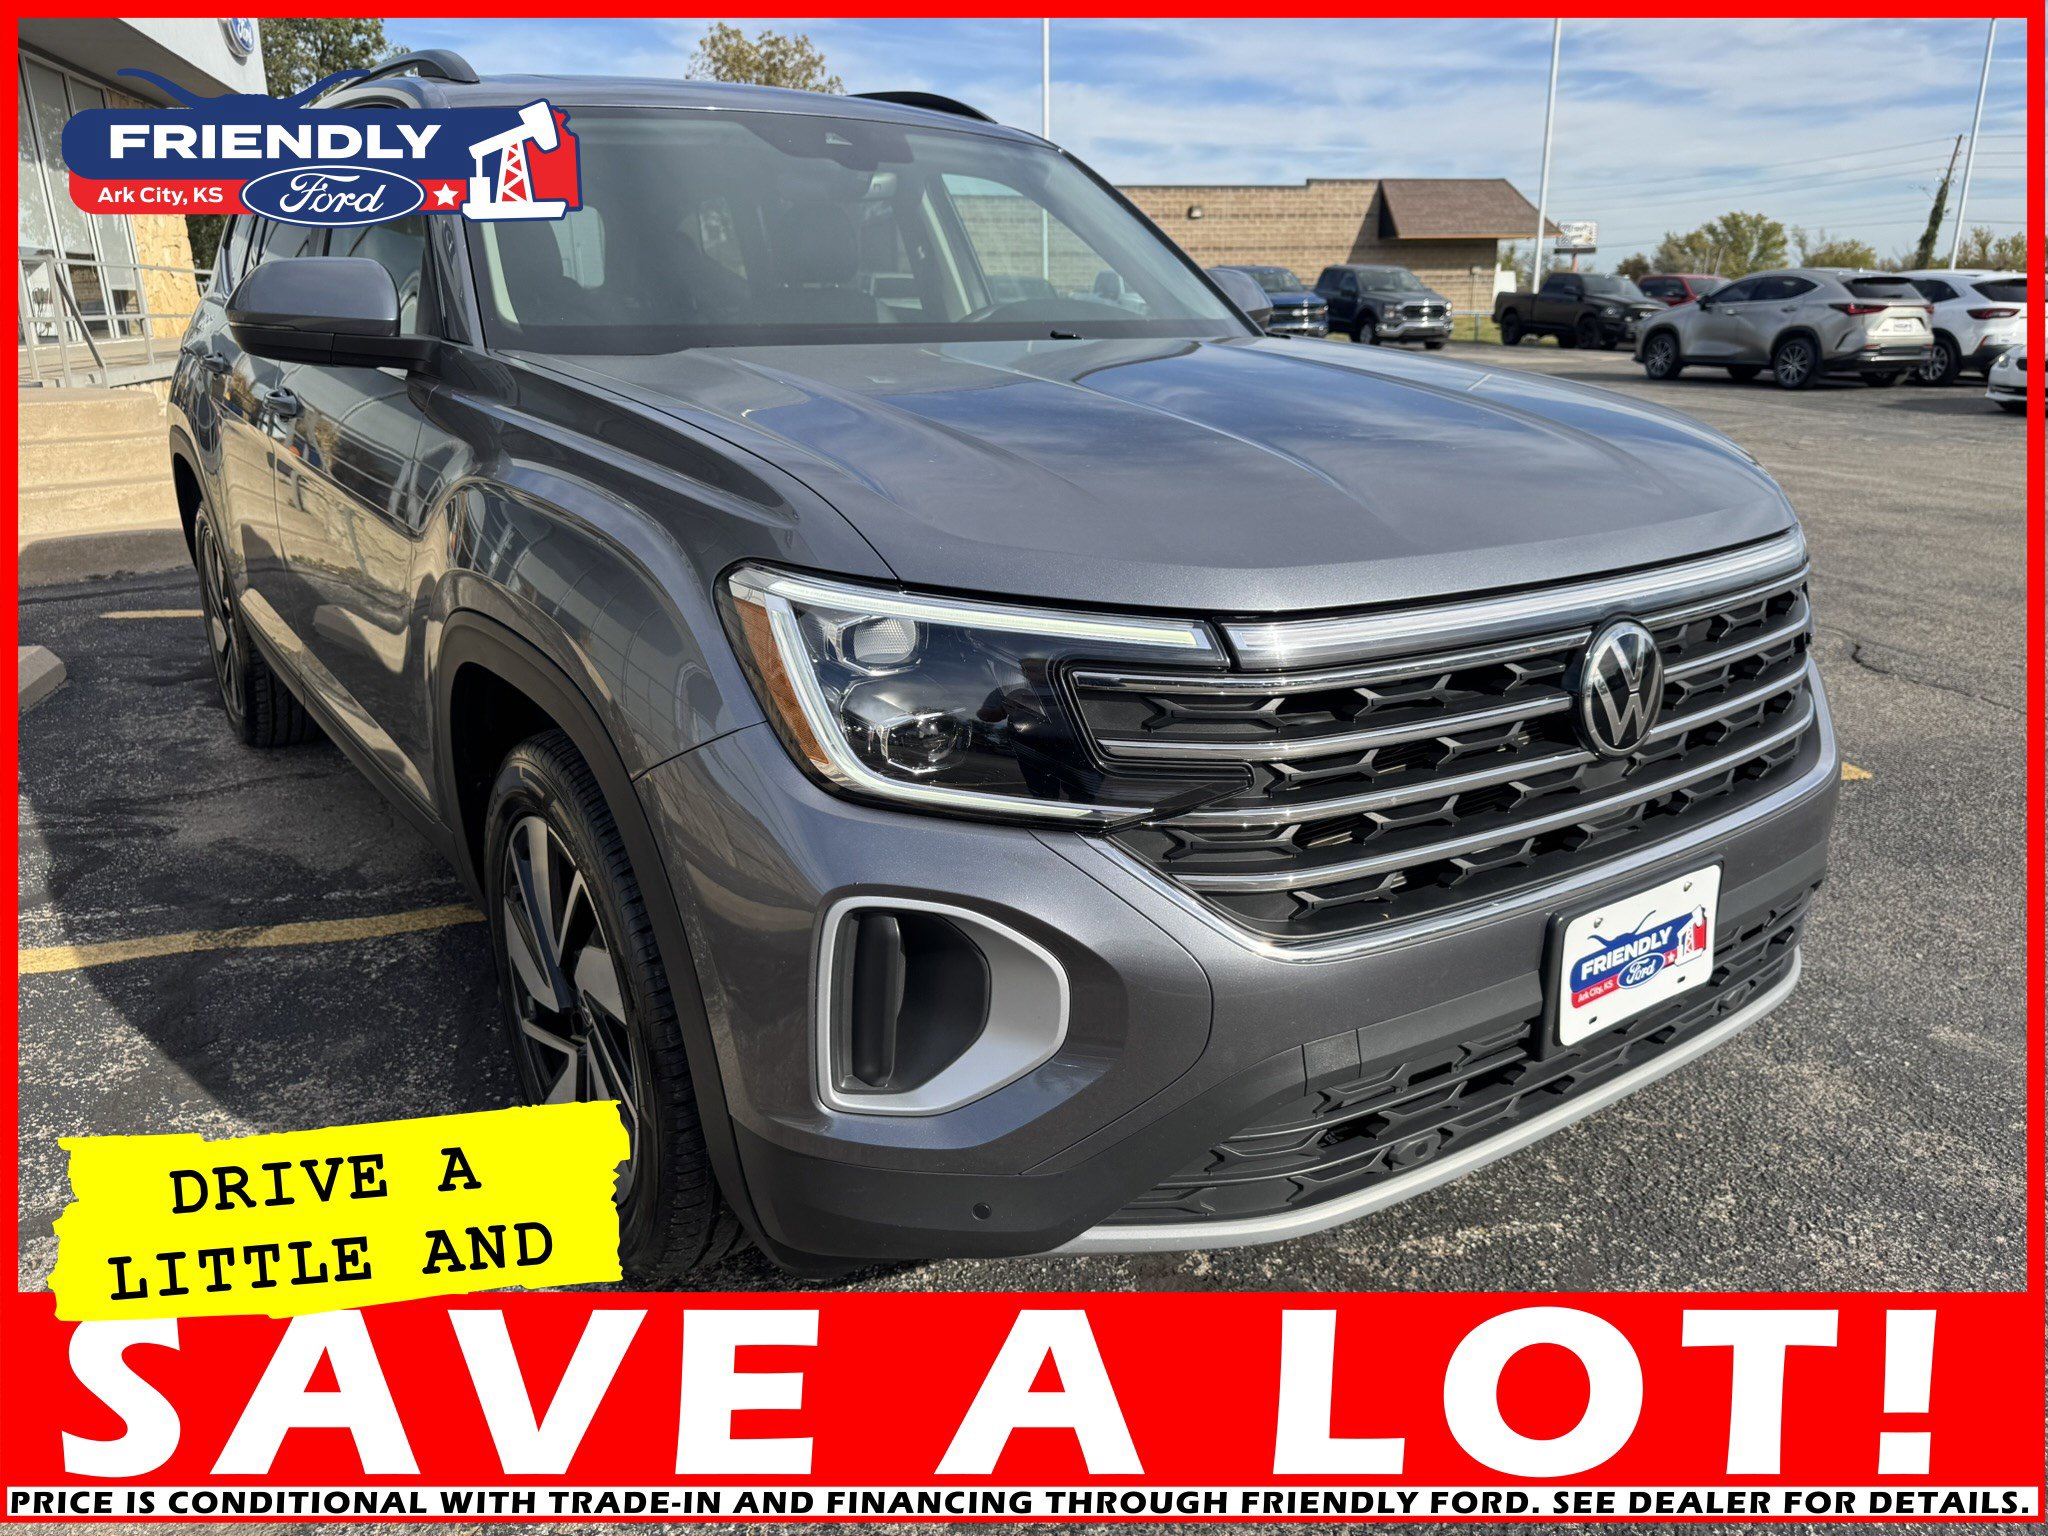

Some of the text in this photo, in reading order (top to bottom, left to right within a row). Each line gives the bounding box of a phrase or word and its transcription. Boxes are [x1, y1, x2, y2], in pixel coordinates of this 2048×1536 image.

[1581, 926, 1673, 981] FRIENDLY
[1625, 957, 1657, 985] Ford
[1577, 989, 1591, 1003] Ark
[1602, 979, 1614, 991] KS
